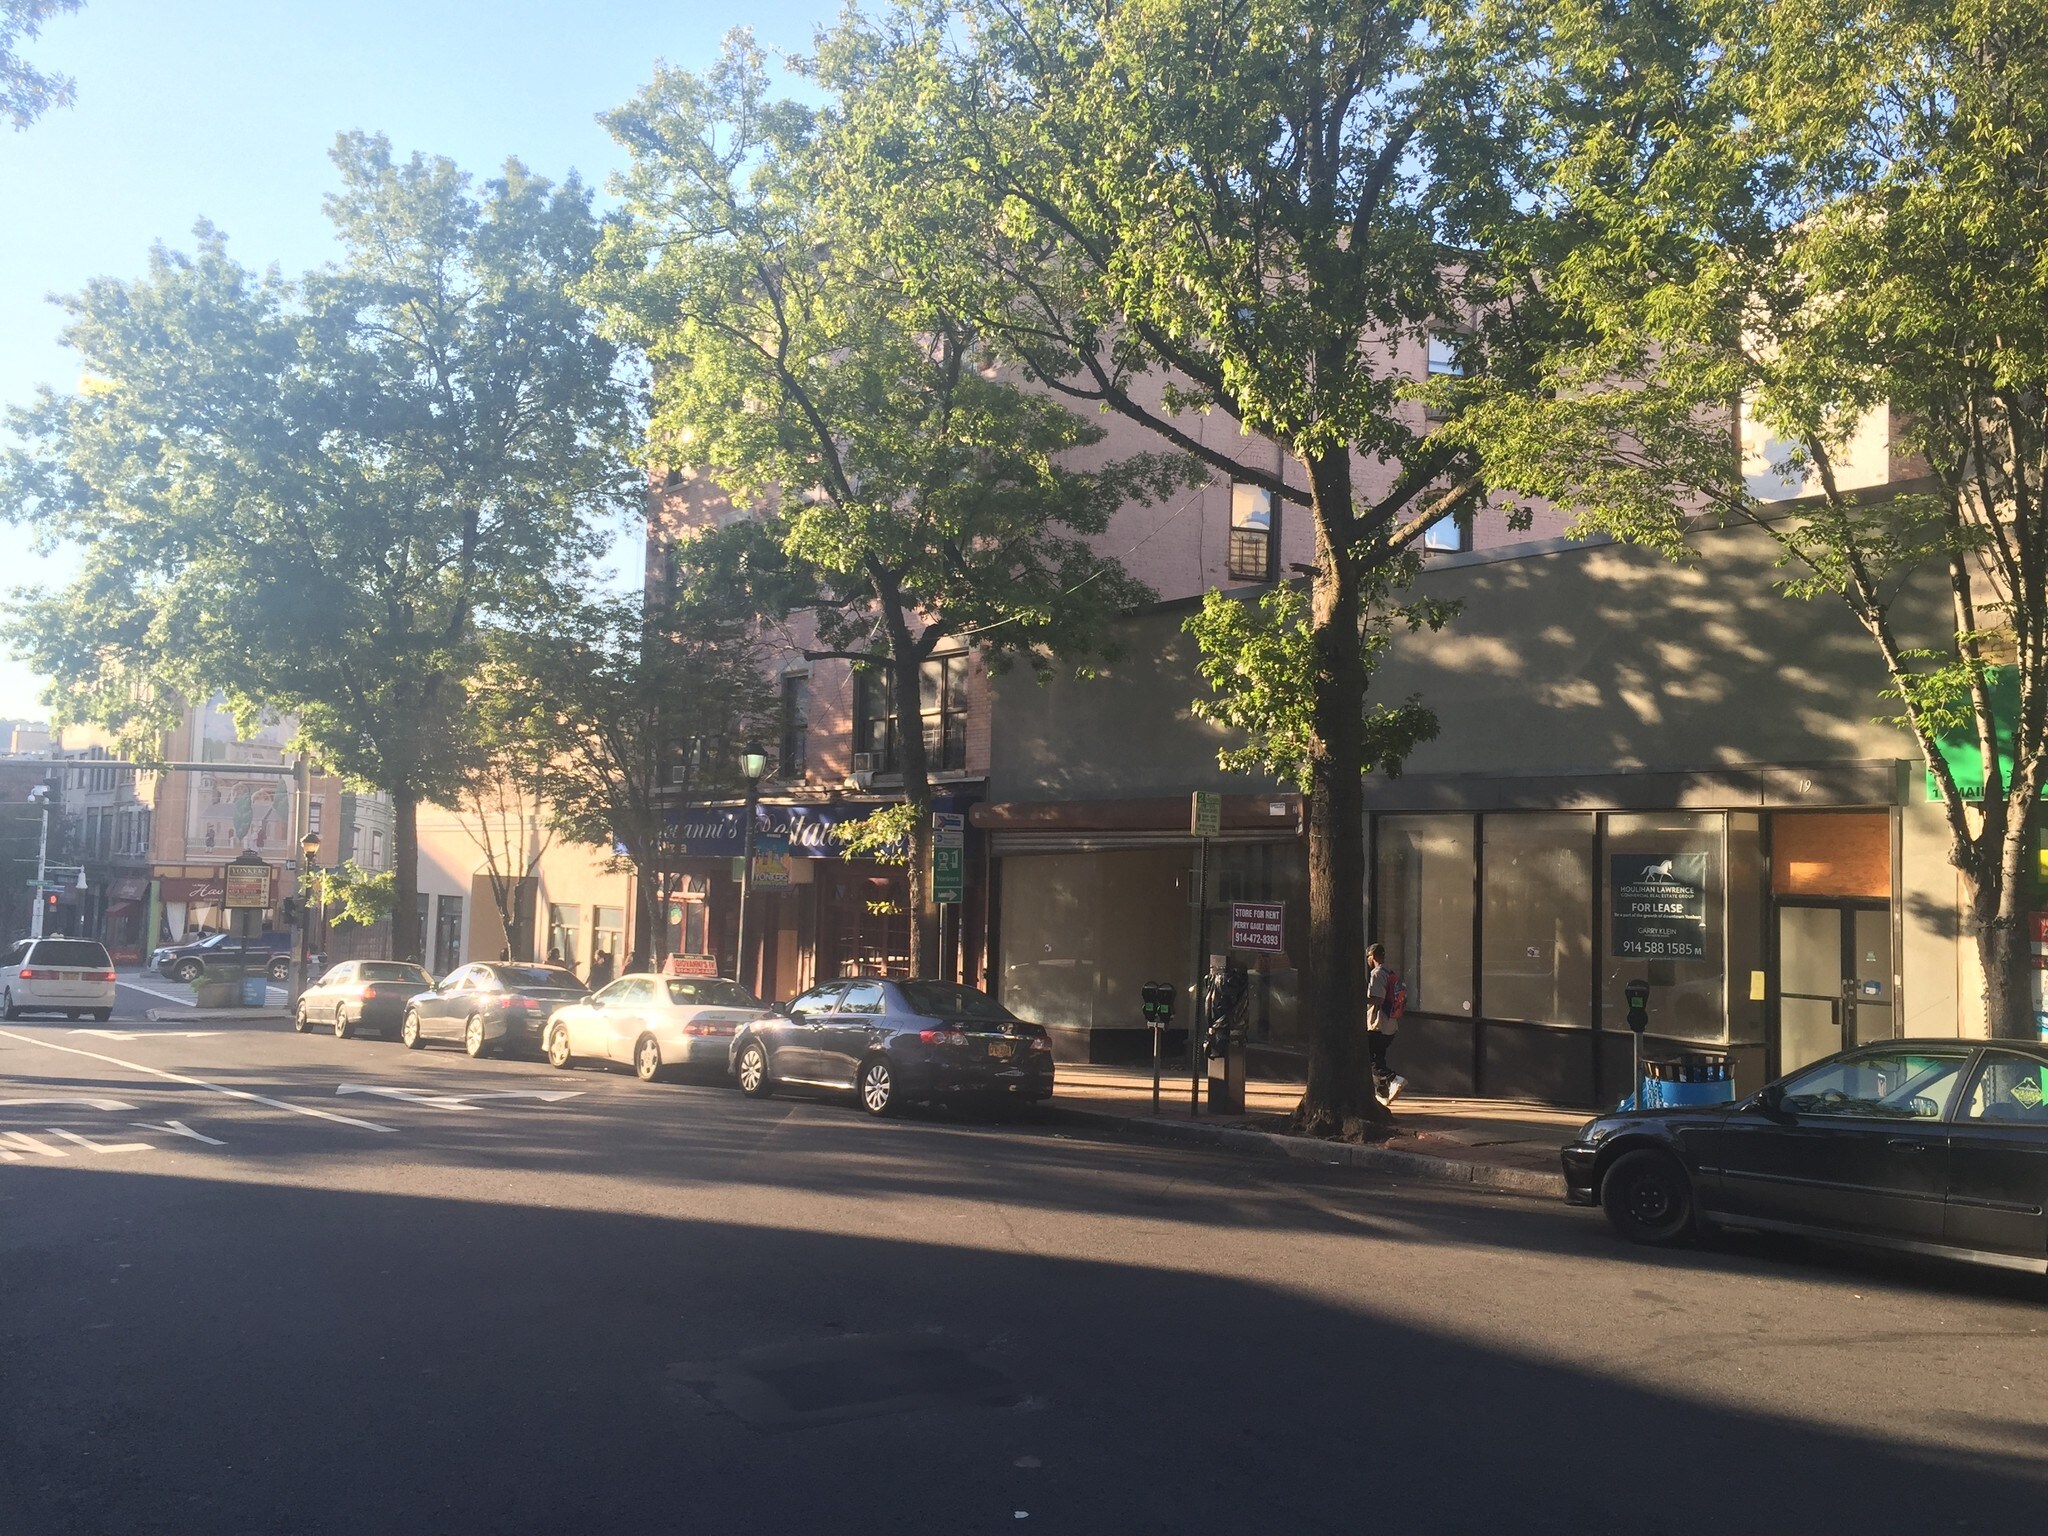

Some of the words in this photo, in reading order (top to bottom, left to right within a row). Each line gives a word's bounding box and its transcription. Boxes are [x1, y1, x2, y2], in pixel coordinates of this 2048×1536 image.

[1799, 779, 1812, 793] 19
[1957, 786, 1985, 798] MAI
[189, 884, 224, 897] Hav
[1235, 908, 1252, 918] STORE
[1253, 909, 1264, 918] FOR
[1265, 910, 1279, 919] RENT
[1631, 903, 1651, 912] FOR
[1653, 903, 1683, 913] LEASE
[1234, 921, 1249, 929] PERRY
[1265, 923, 1280, 932] MGMT
[1235, 932, 1279, 945] 914-472-8393
[1623, 941, 1642, 952] 914
[1644, 942, 1664, 953] 588
[1667, 943, 1692, 955] 1585
[0, 1120, 228, 1161] NLY
